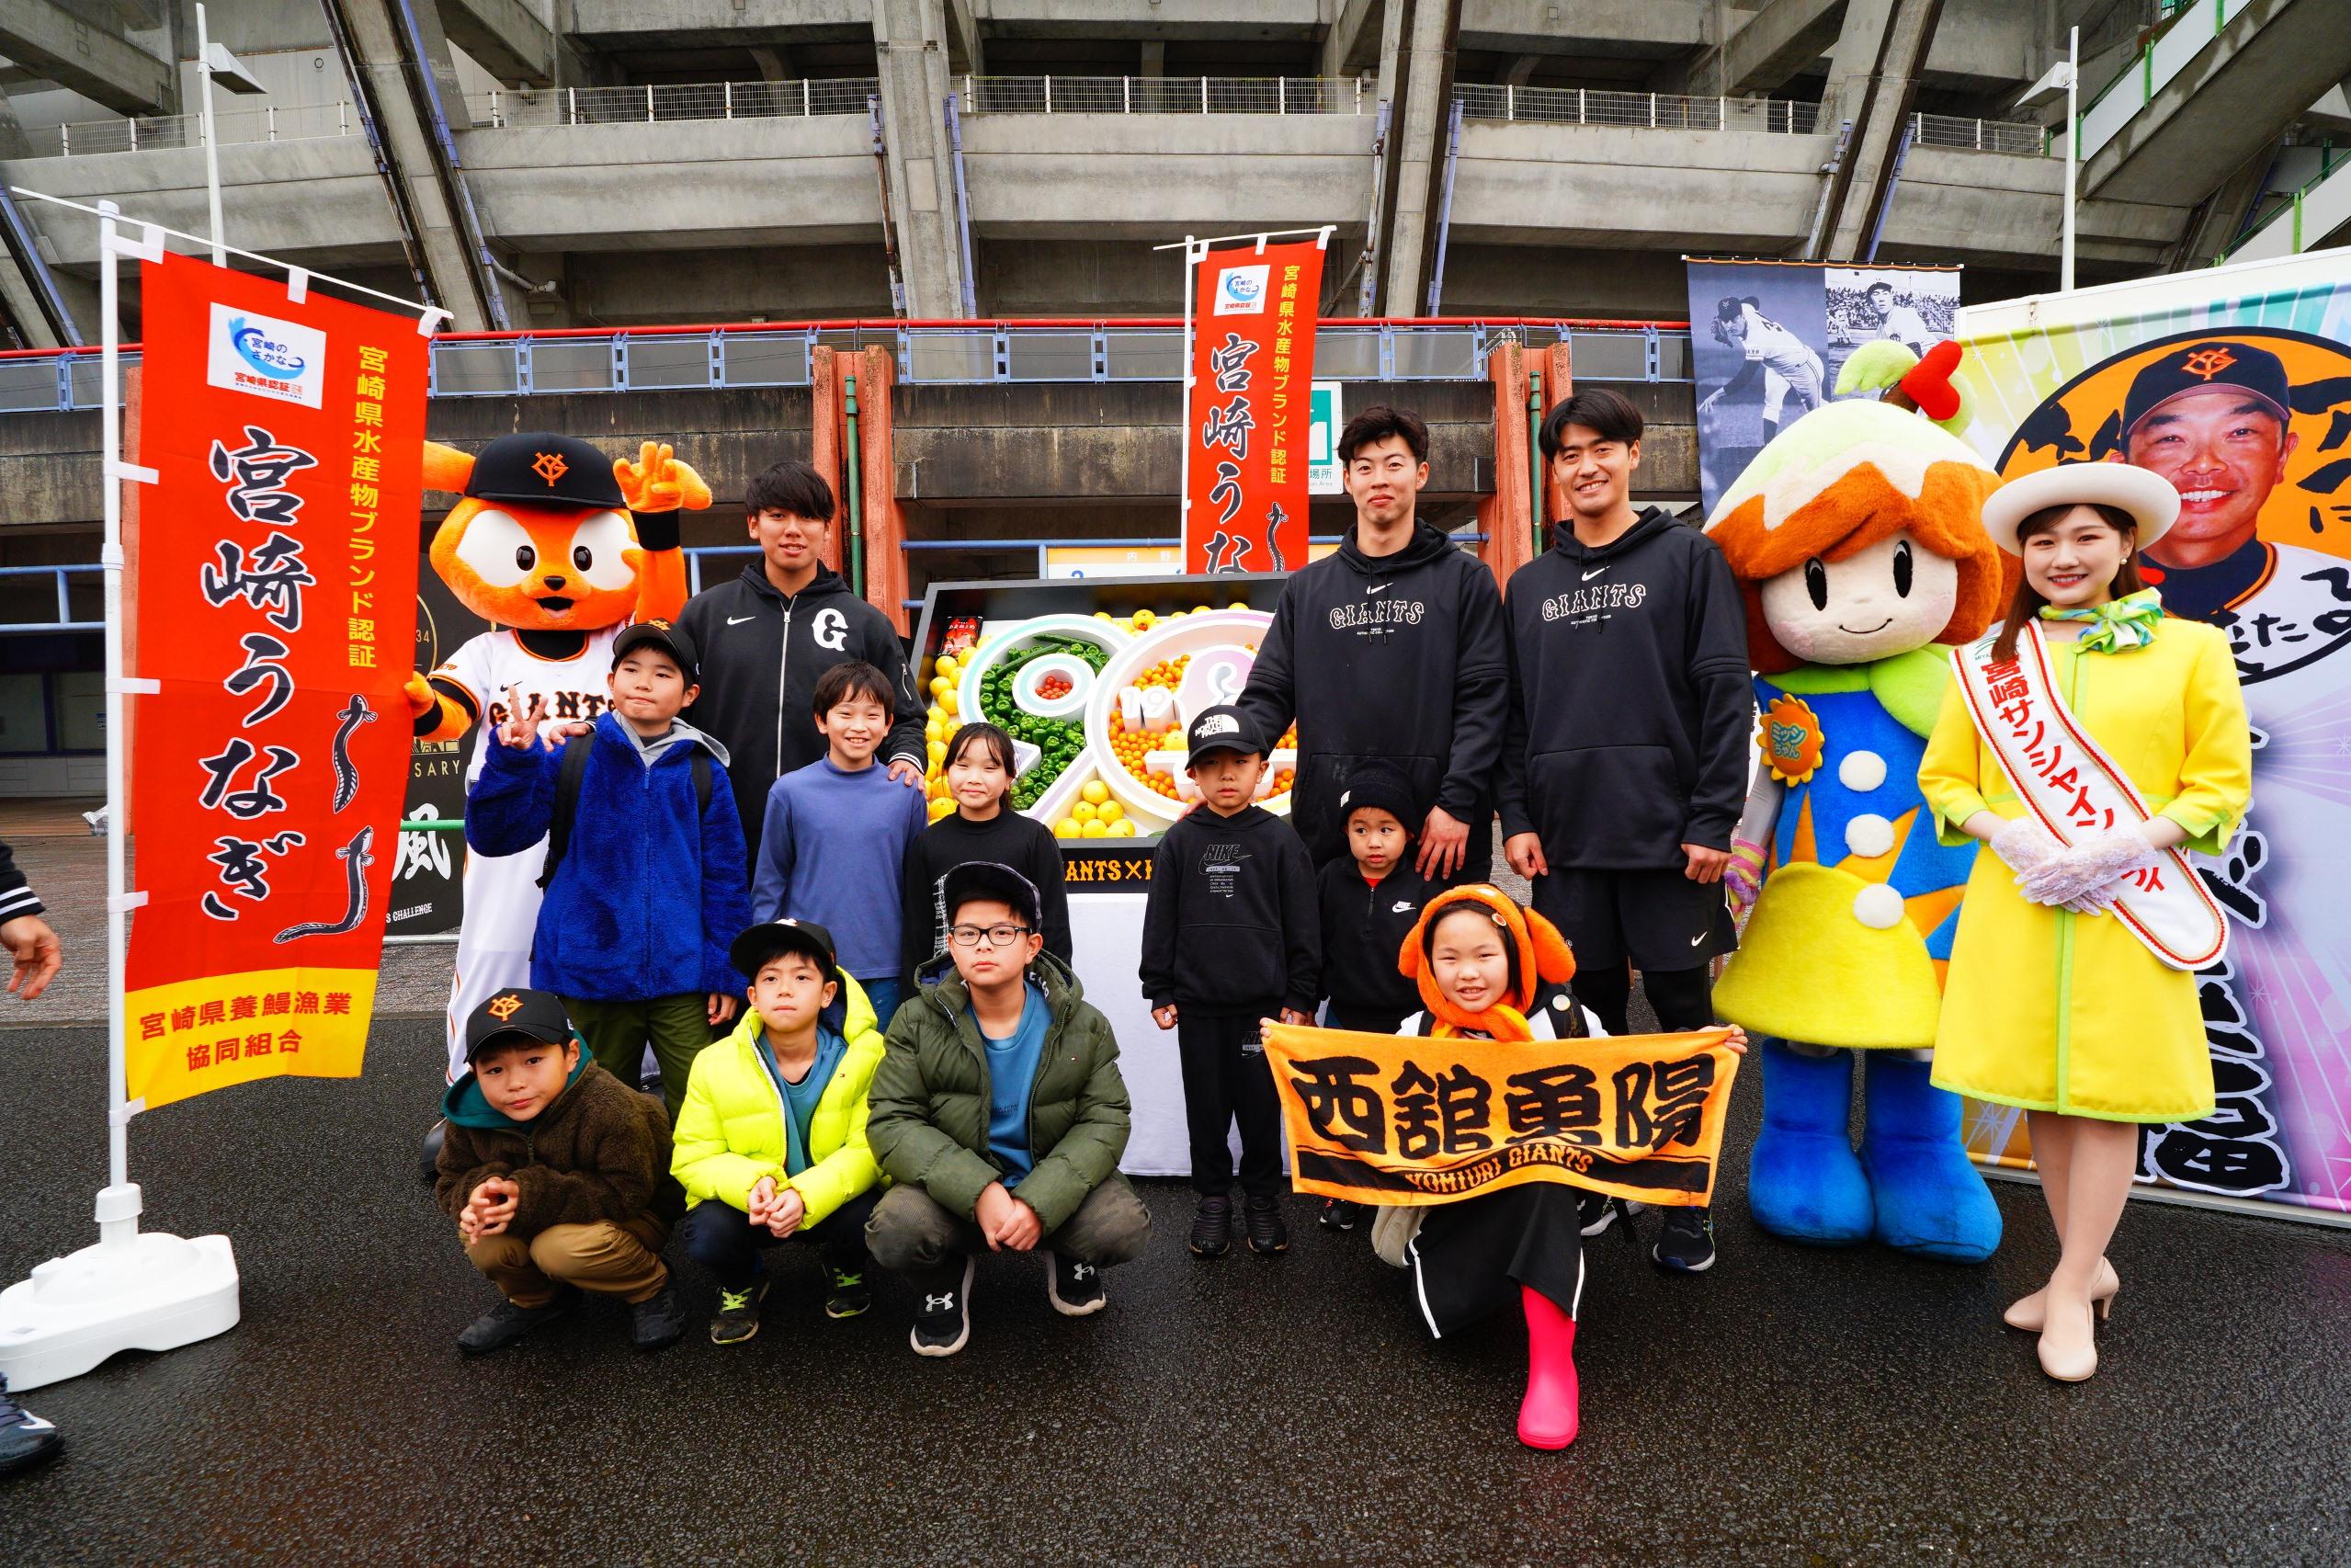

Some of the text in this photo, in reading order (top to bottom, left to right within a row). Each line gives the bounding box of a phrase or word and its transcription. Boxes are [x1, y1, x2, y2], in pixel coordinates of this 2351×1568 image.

[251, 337, 288, 354] 宮崎の
[252, 350, 287, 365] さかな
[1271, 265, 1300, 483] 宮崎県水産物ブランド認証
[1310, 468, 1332, 480] 場所
[348, 346, 388, 668] 宮崎県水産物ブランド認証
[1329, 600, 1425, 630] GIANTS
[1542, 584, 1646, 621] GIANTS
[812, 608, 848, 652] G
[199, 426, 319, 921] 宮崎うなぎ
[392, 903, 433, 922] CHALLENGE
[140, 991, 353, 1040] 宮崎県養鰻漁業
[187, 1028, 302, 1071] 協同組合
[1404, 1144, 1595, 1193] YOMIURI GIANTS
